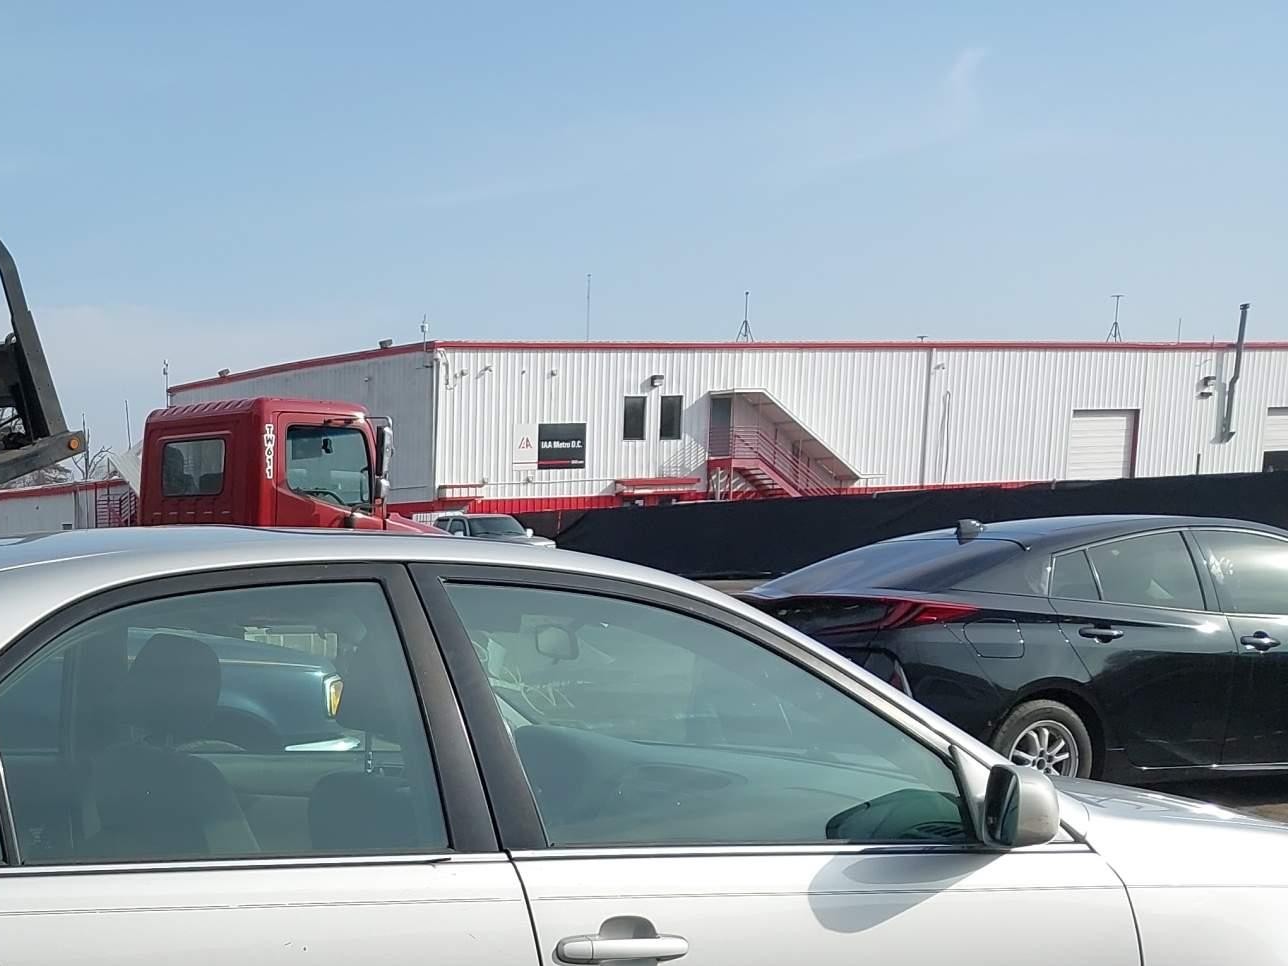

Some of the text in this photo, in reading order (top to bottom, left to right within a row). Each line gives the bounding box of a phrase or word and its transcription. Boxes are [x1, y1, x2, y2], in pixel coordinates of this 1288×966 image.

[264, 423, 275, 479] TW611
[541, 440, 583, 449] IAA Metro D.C.
